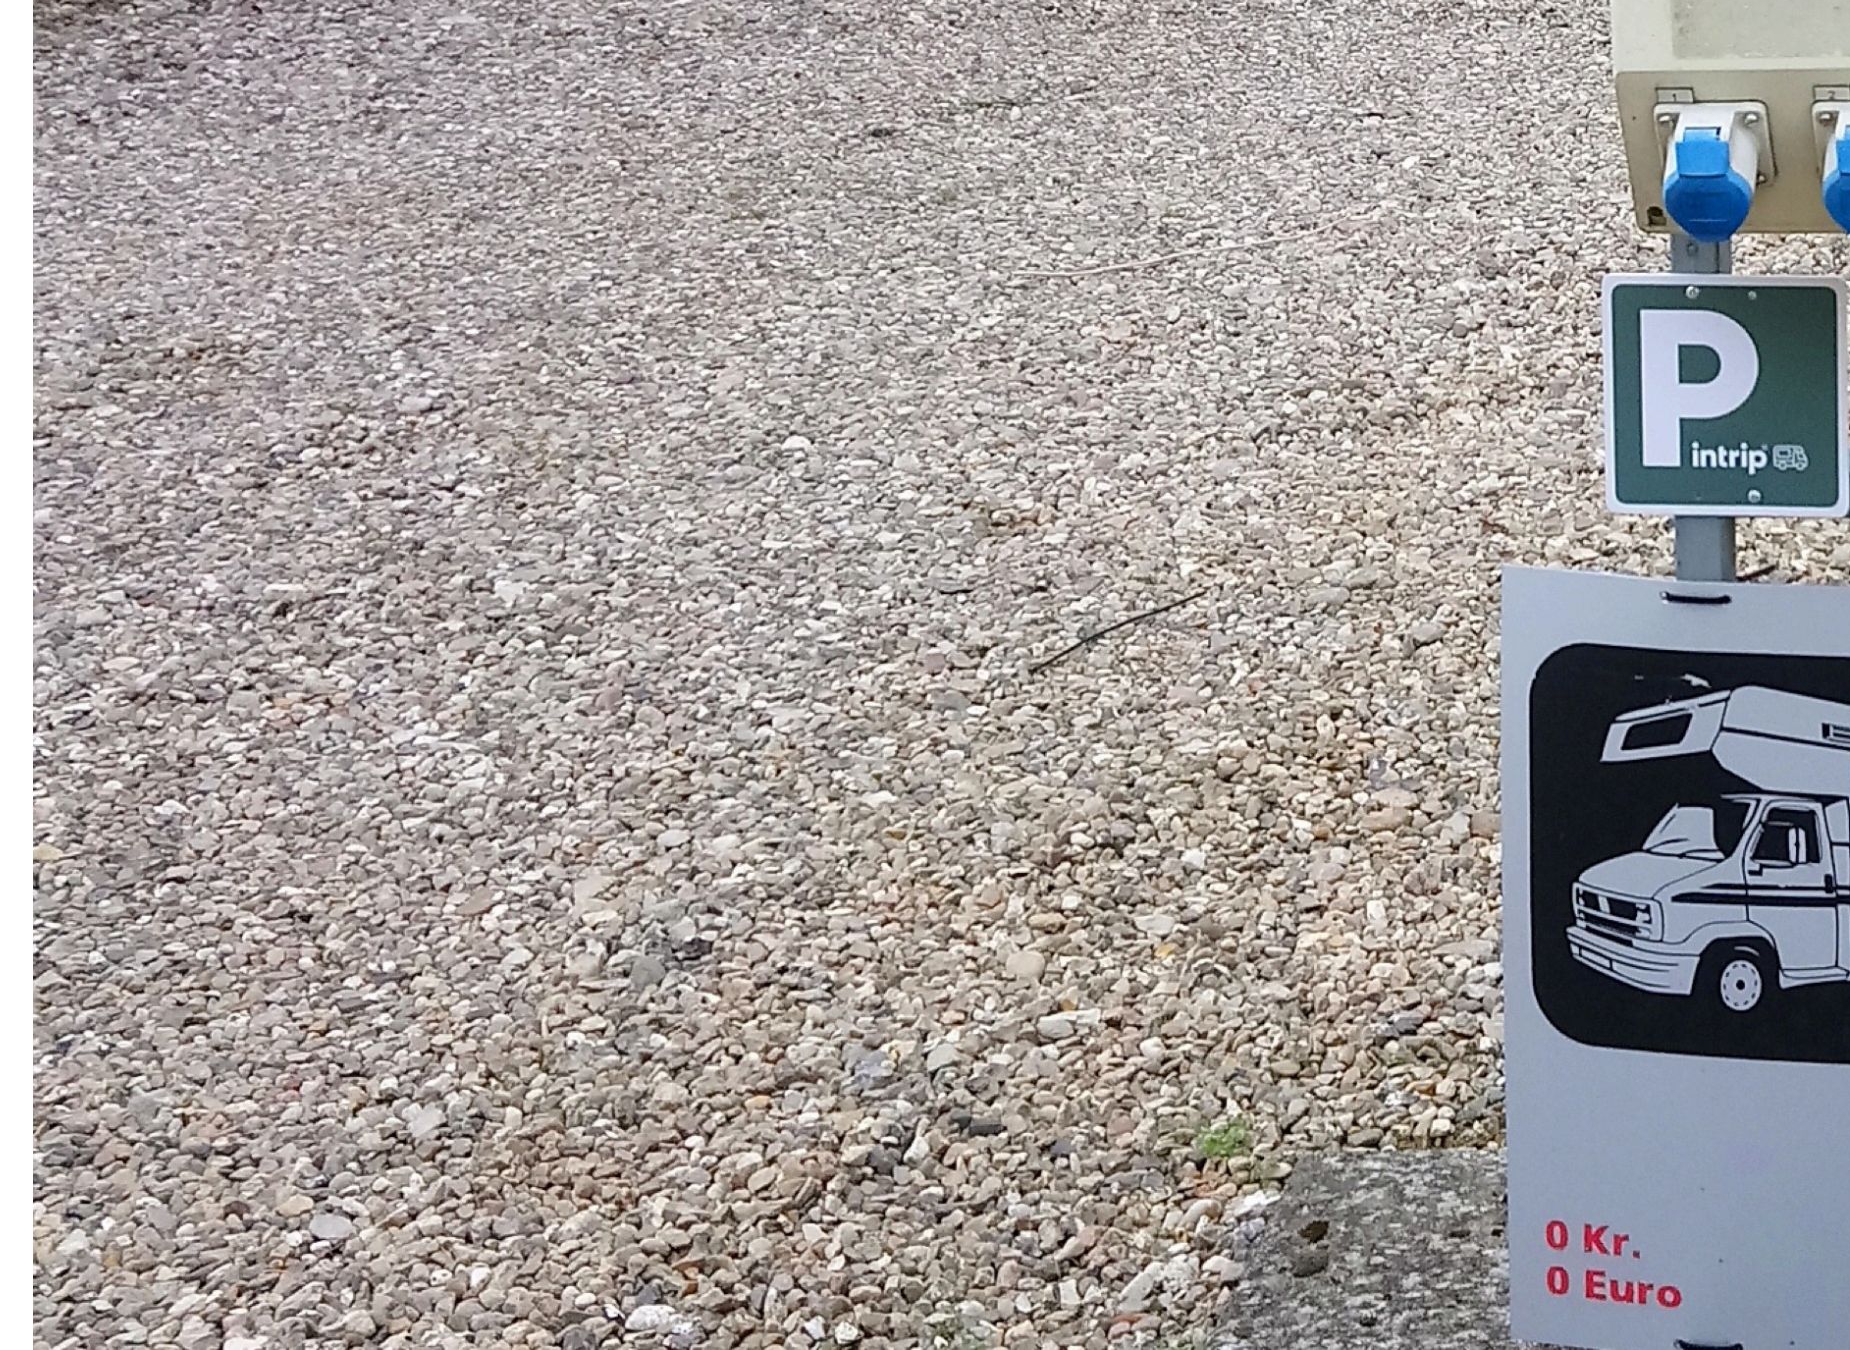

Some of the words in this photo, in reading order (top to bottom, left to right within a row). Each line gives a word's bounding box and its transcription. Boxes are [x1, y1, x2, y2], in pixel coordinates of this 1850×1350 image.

[1640, 309, 1759, 467] P
[1691, 441, 1768, 475] intrip
[1545, 1221, 1569, 1250] 0
[1583, 1224, 1640, 1259] Kr.
[1546, 1266, 1569, 1296] 0
[1585, 1270, 1682, 1309] Euro
